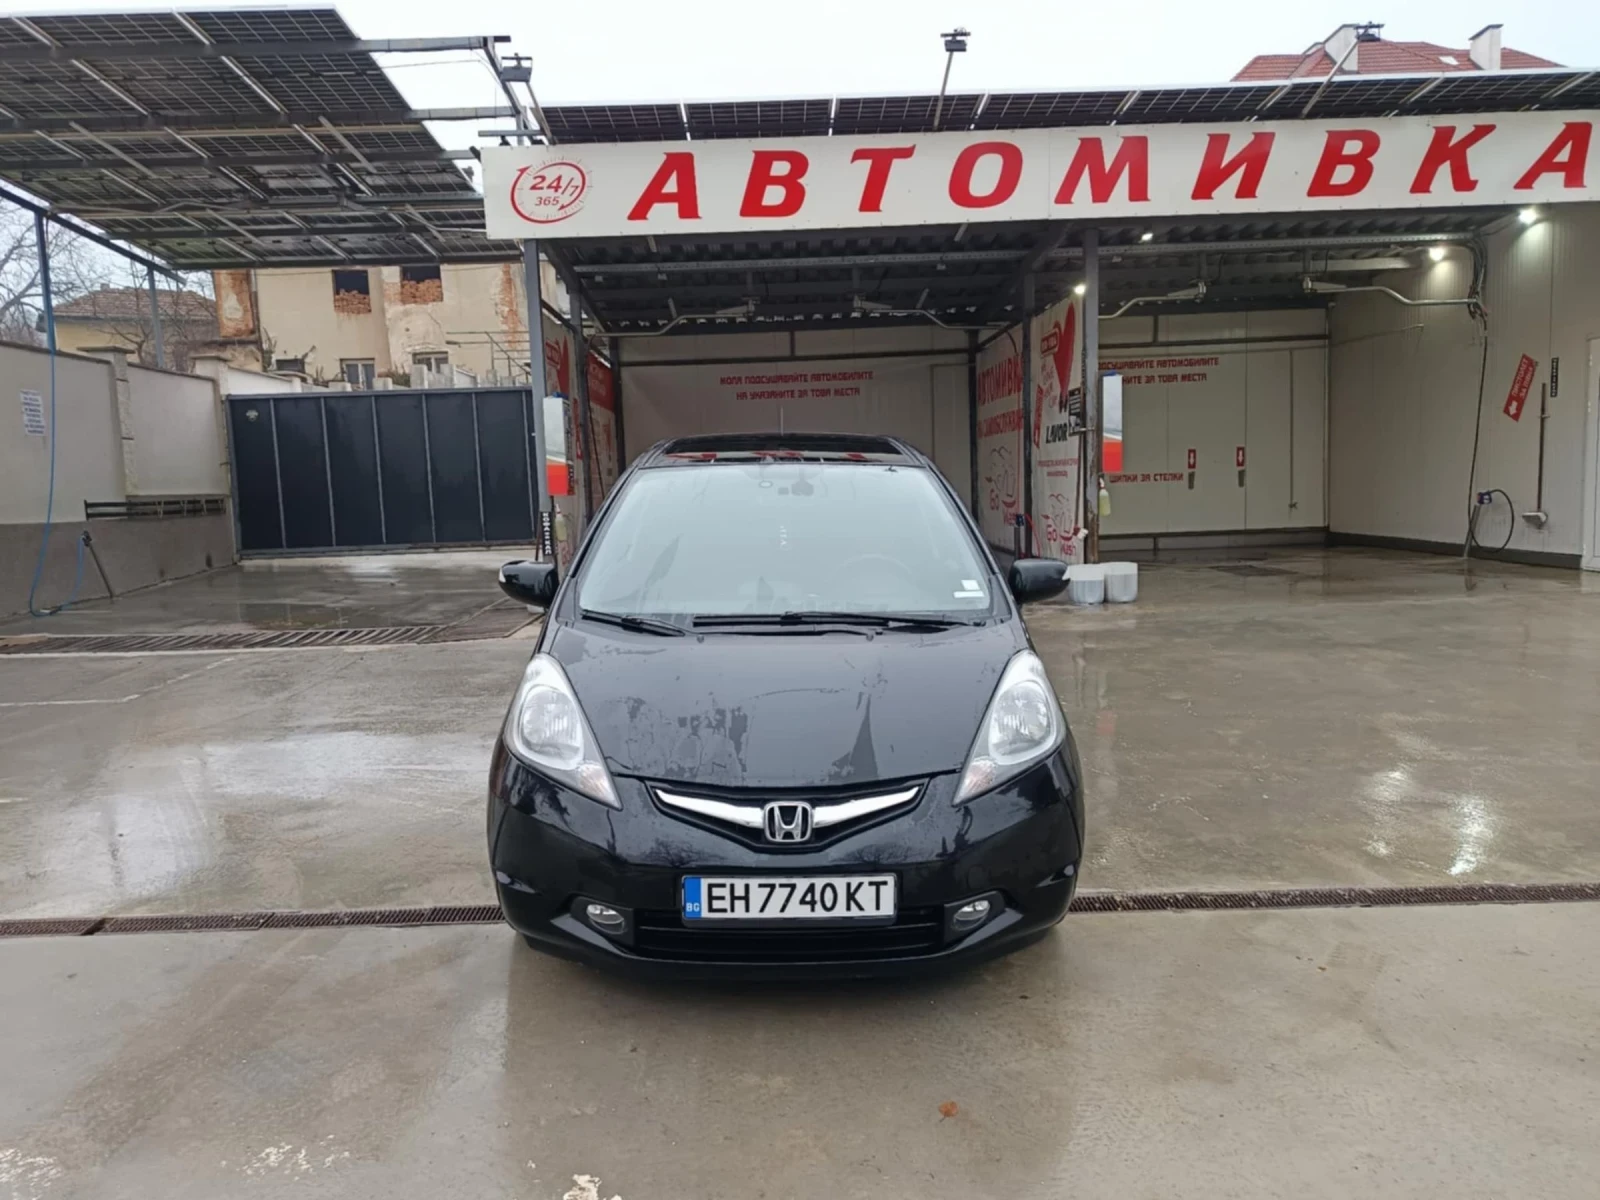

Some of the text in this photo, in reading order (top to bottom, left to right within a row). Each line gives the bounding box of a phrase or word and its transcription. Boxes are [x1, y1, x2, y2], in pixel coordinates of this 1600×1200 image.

[627, 121, 1593, 221] АВТОМИВКА
[529, 174, 580, 197] 24/7
[534, 196, 560, 207] 365
[811, 371, 874, 382] АВТОМОБИЛИТЕ
[1181, 373, 1207, 382] МЕСТА
[834, 387, 861, 397] МЕСТА
[686, 902, 700, 912] BG
